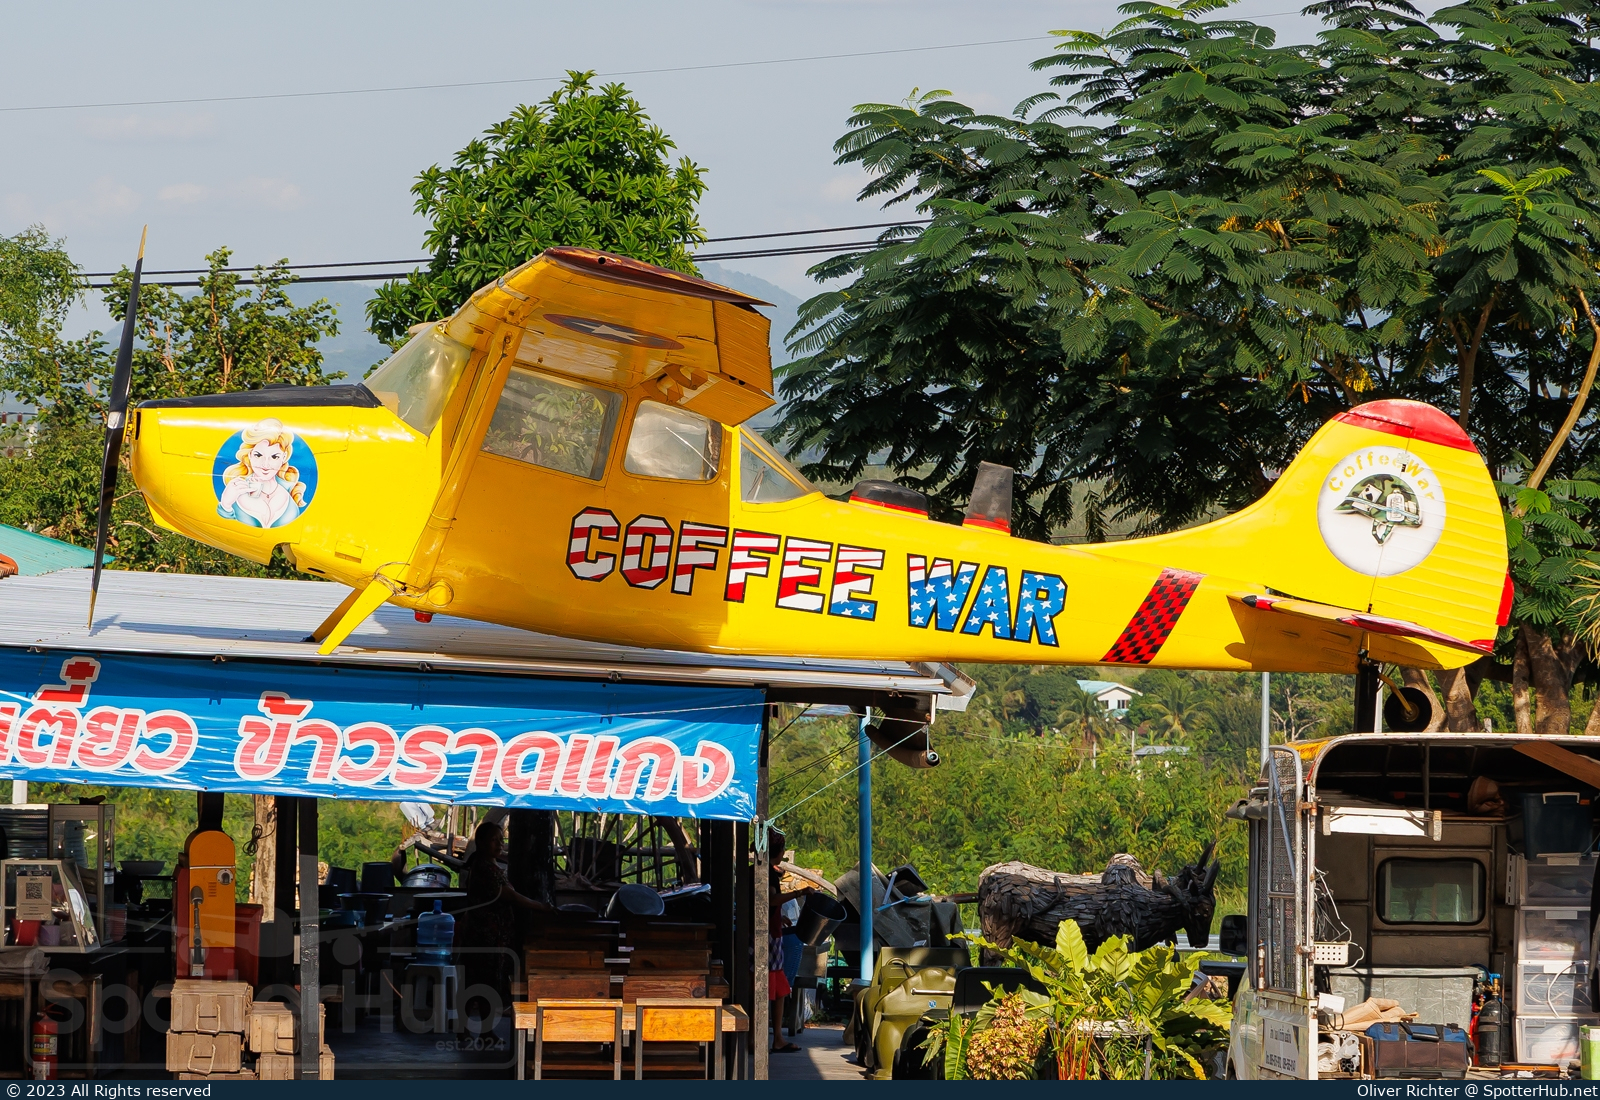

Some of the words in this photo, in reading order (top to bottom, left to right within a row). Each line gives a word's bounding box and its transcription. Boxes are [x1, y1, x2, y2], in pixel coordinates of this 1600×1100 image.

[565, 506, 885, 621] COFFEE
[907, 553, 1068, 647] WAR
[234, 691, 736, 804] ข้าวราดแกง
